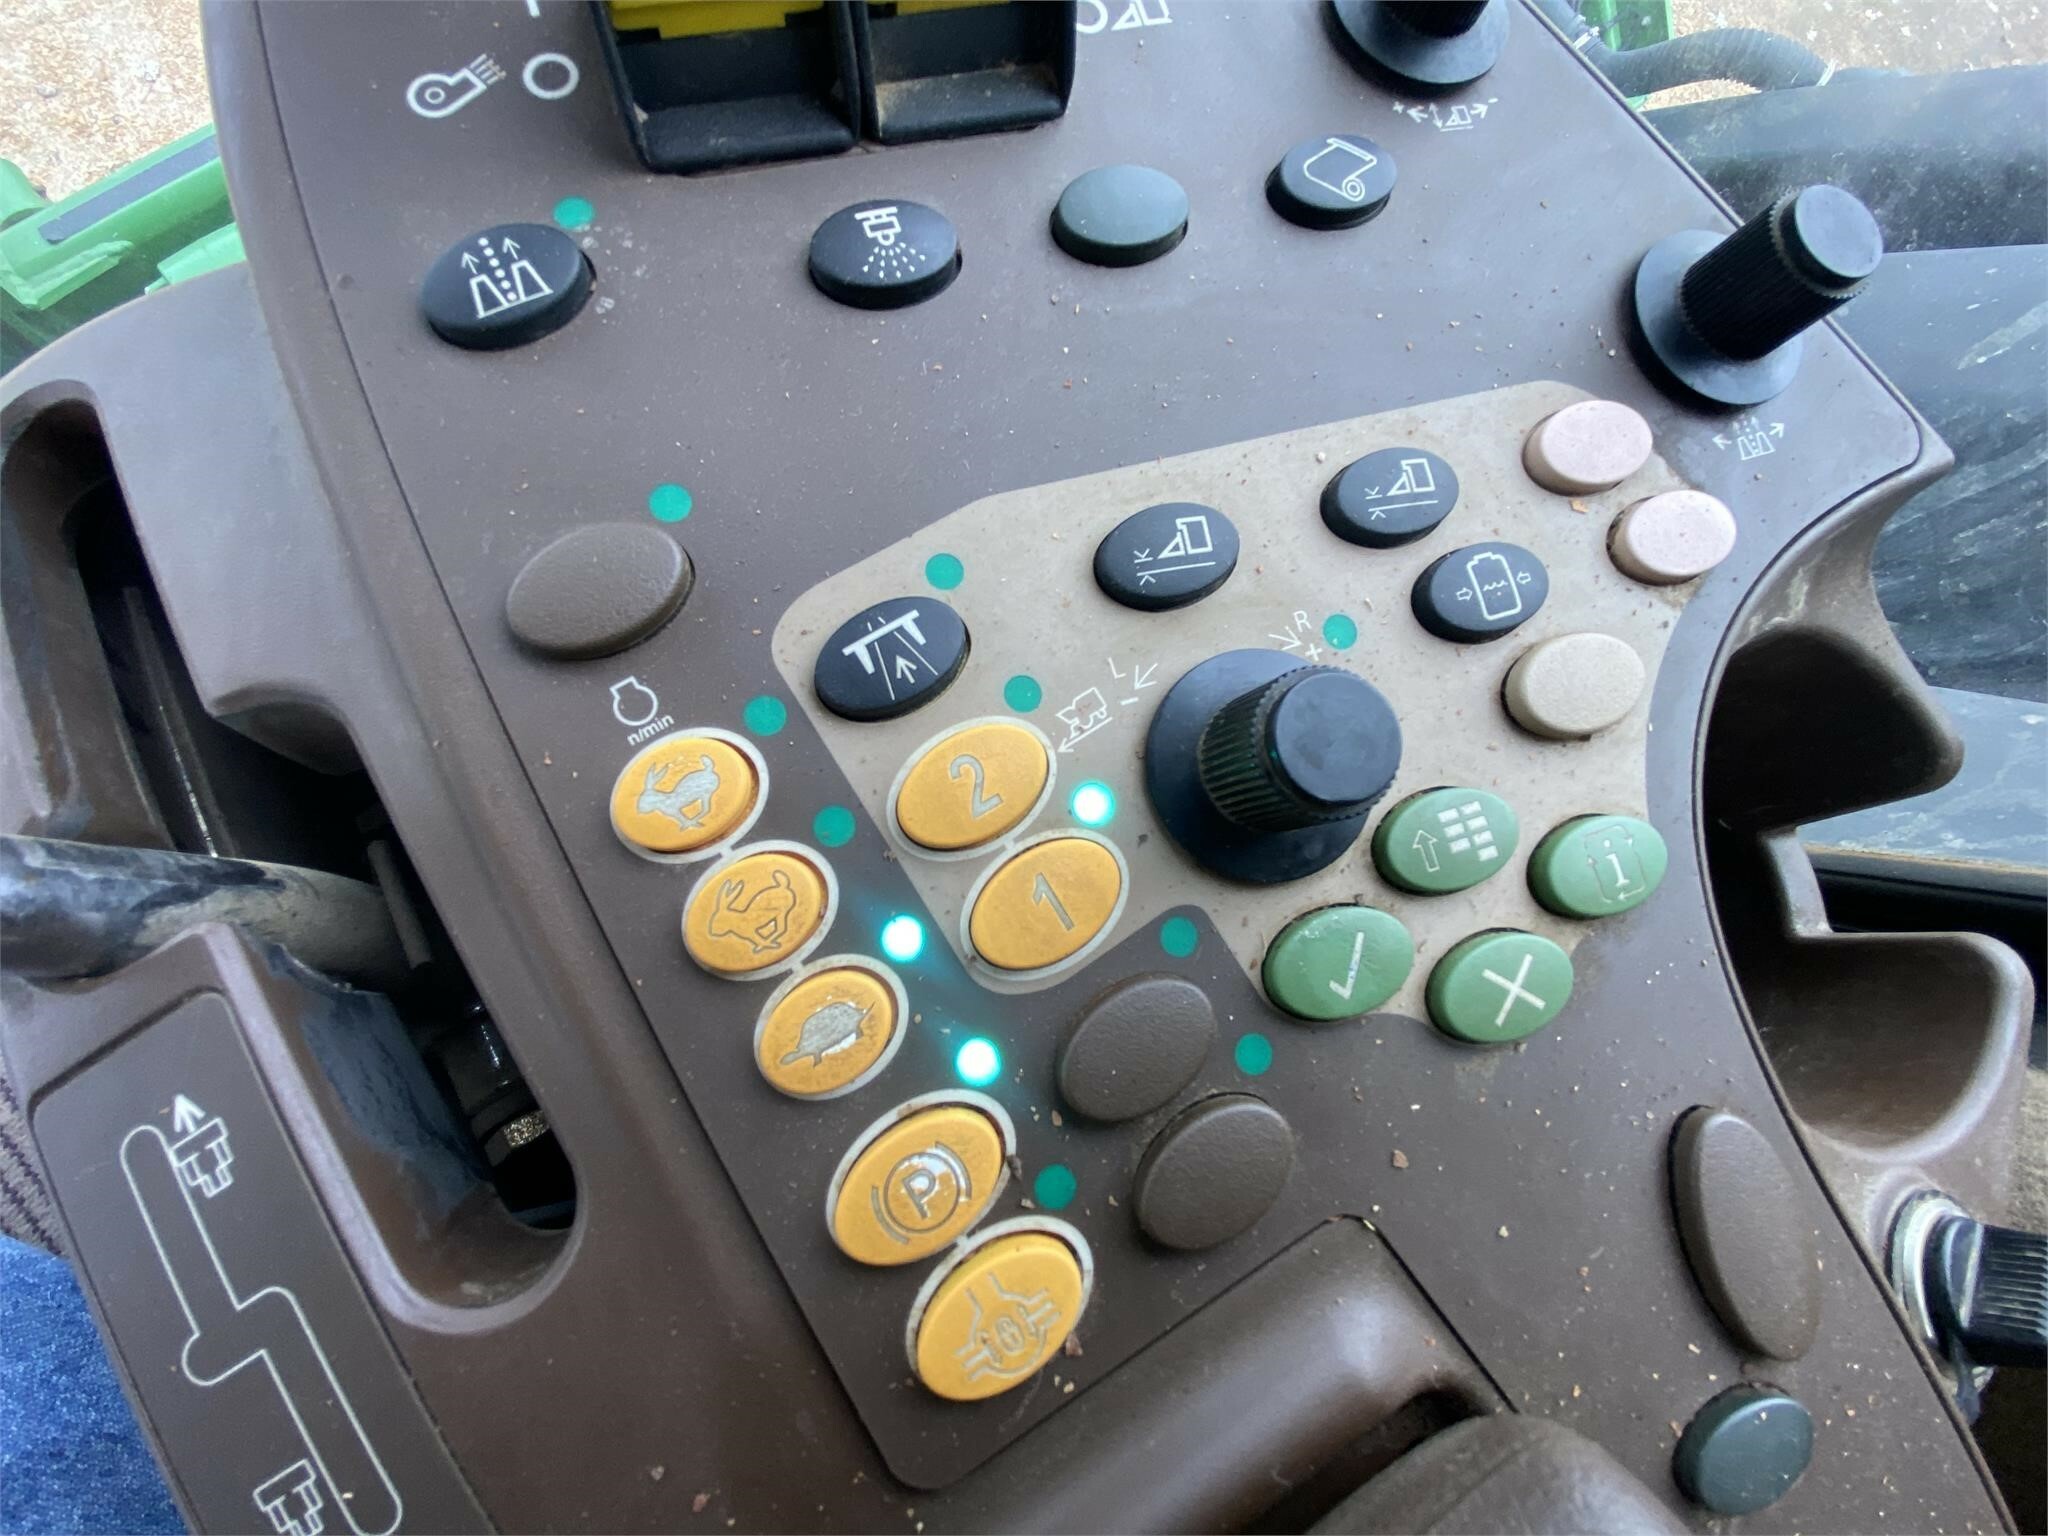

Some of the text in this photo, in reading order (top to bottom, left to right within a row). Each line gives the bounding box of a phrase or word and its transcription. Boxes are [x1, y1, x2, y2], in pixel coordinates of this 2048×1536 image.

[1293, 610, 1312, 632] R
[1108, 657, 1126, 679] L
[627, 715, 675, 746] n/min
[950, 754, 1004, 820] 2
[1032, 871, 1075, 931] 1
[902, 1168, 938, 1220] P
